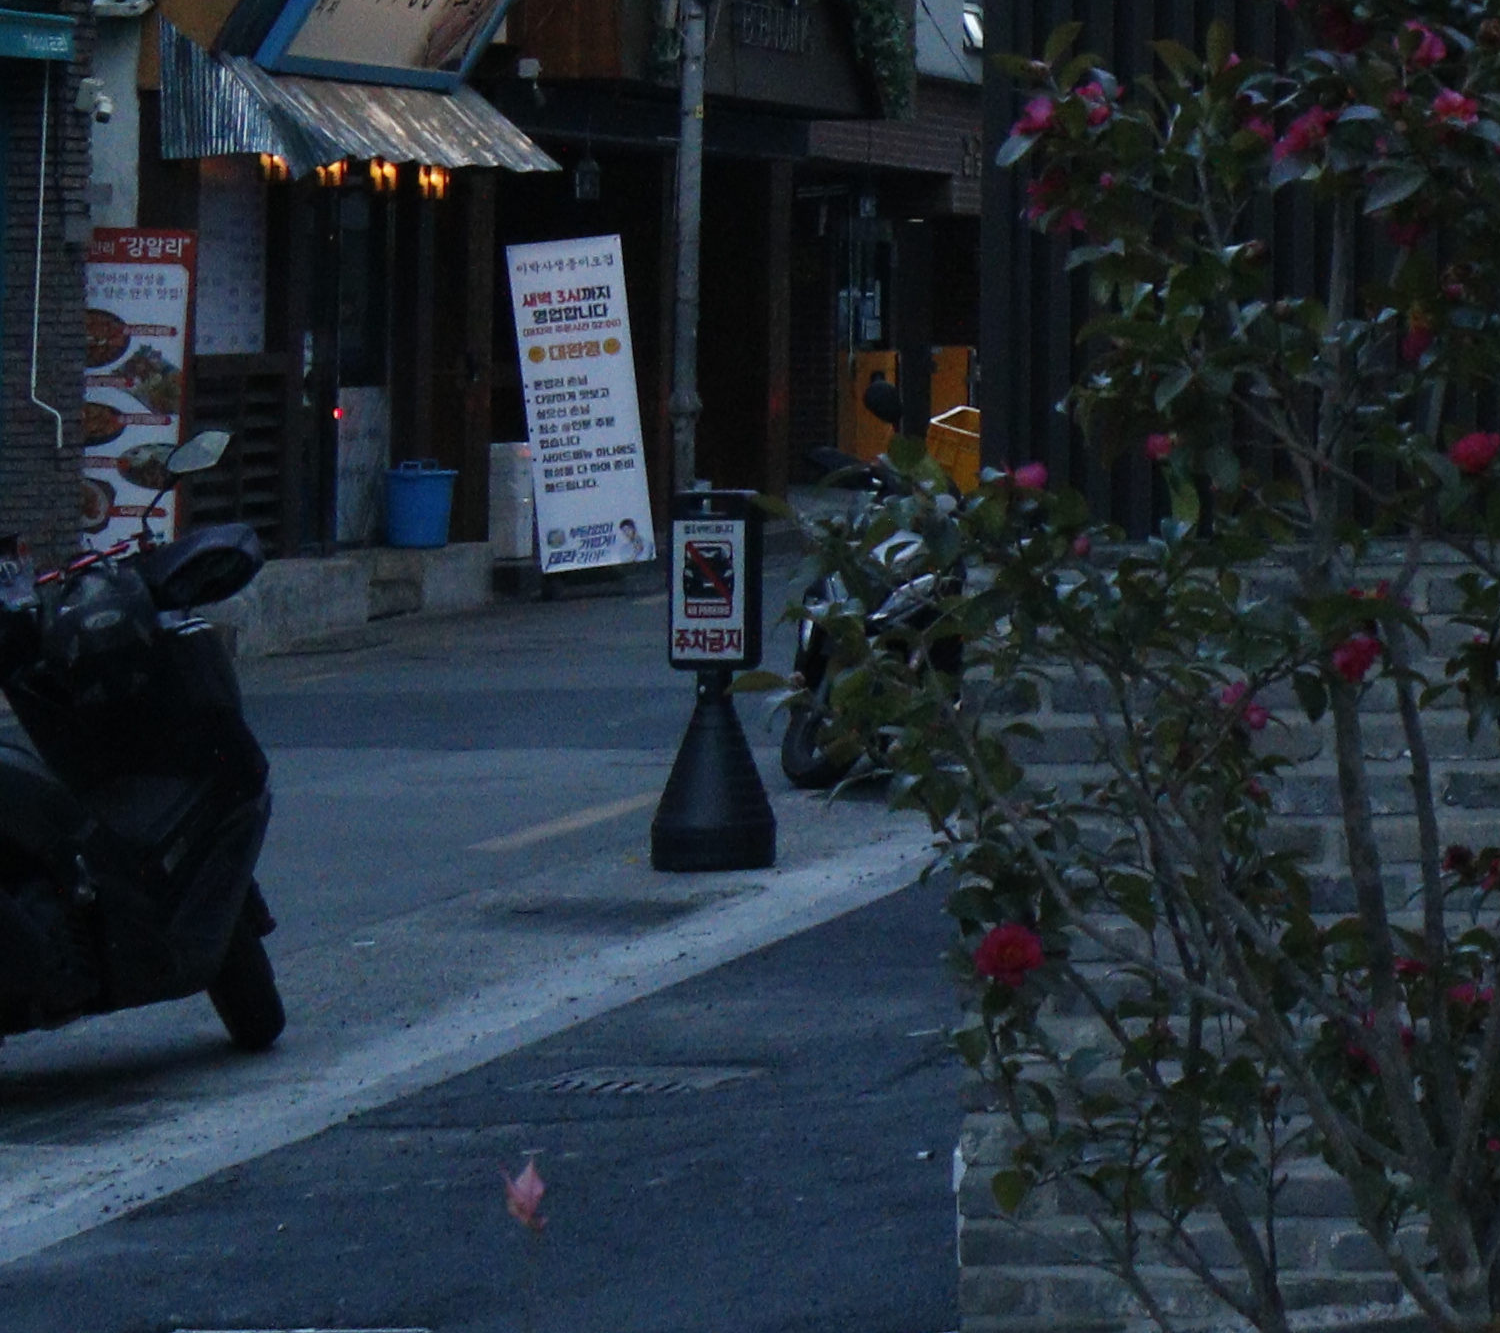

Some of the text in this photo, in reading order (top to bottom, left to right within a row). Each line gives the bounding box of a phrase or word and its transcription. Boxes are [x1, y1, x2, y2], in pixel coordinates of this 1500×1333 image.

[522, 285, 611, 307] 새벽 3시까지
[533, 303, 610, 324] 영업합니다
[549, 340, 601, 361] 대환영
[566, 375, 588, 386] 손님
[535, 391, 577, 405] 다양하게
[569, 404, 591, 416] 손님
[674, 627, 742, 654] 주차금지
